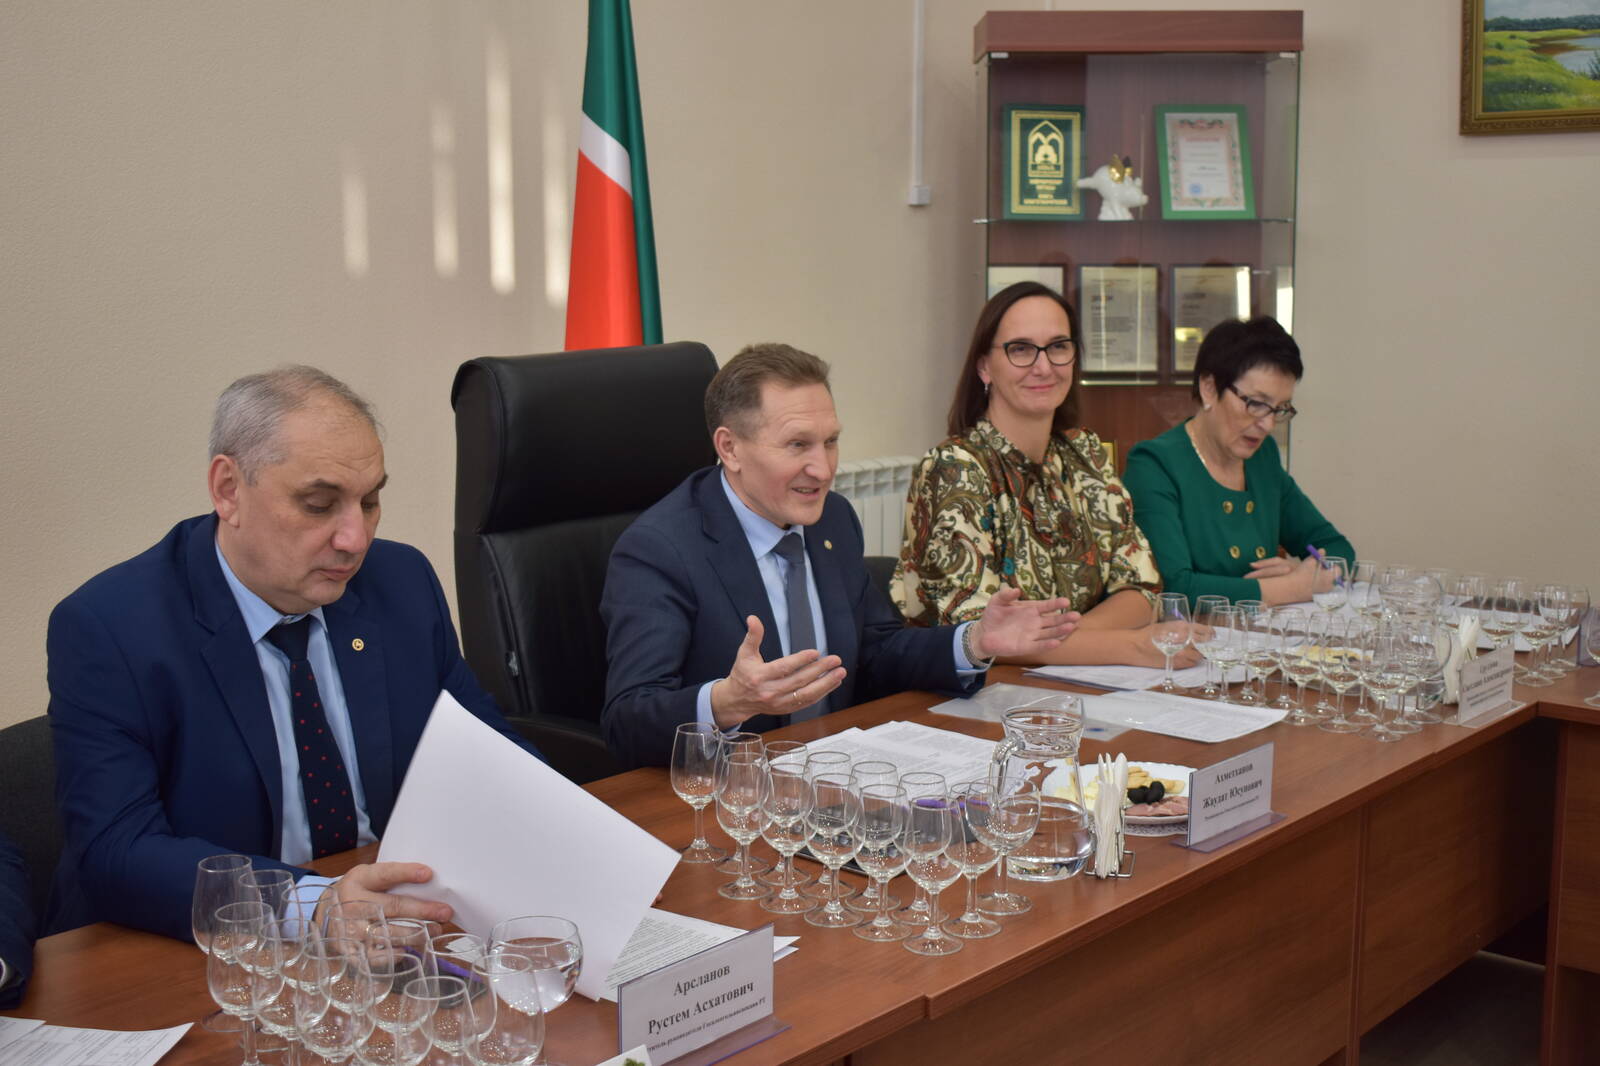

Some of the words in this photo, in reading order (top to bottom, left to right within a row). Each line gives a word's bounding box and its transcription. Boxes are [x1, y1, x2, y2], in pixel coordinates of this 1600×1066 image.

[673, 965, 730, 996] Арсланов
[648, 1008, 690, 1035] Рустем
[693, 982, 754, 1016] Асхатович
